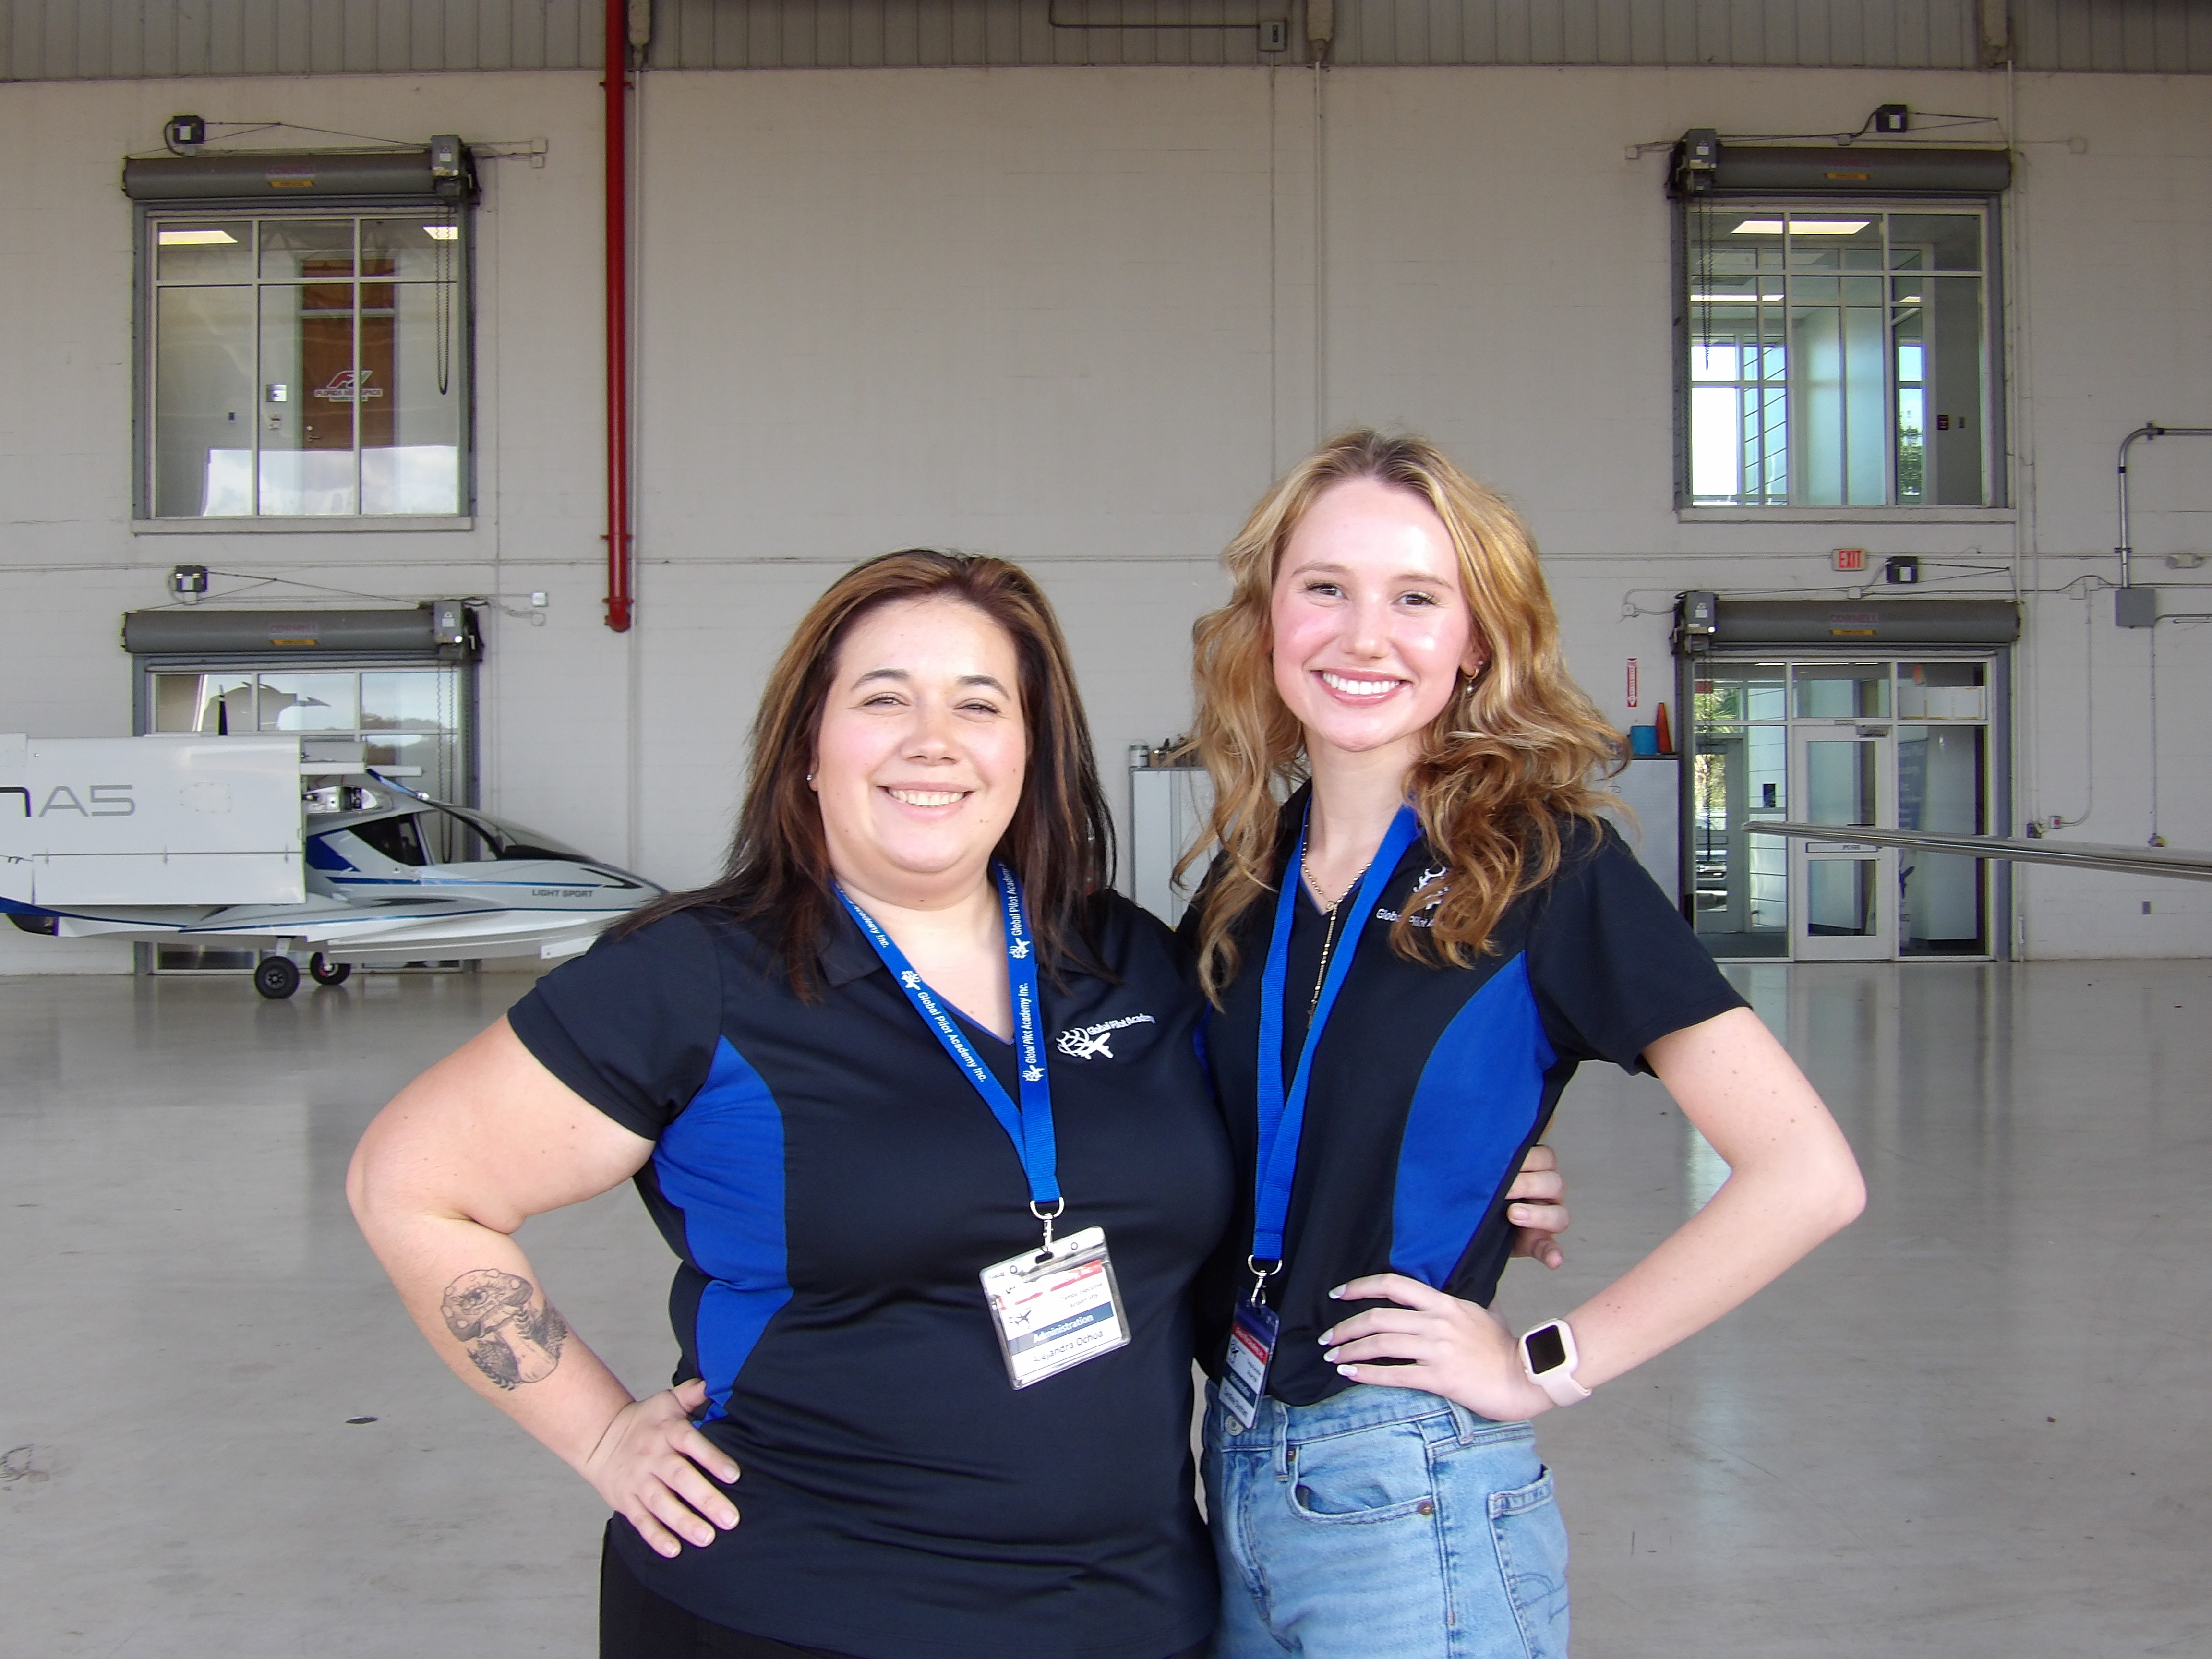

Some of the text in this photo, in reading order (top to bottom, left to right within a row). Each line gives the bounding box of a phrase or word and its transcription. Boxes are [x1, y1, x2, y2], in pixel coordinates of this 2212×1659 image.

[1839, 551, 1861, 568] EXIT
[1008, 896, 1020, 912] Pilot
[1011, 913, 1022, 936] Global
[1019, 998, 1032, 1030] Academy
[917, 992, 941, 1016] Global
[934, 1016, 953, 1034] Pilot
[946, 1034, 978, 1068] Academy
[1022, 1030, 1034, 1045] Pilot
[1023, 1044, 1037, 1064] Global
[1033, 1315, 1094, 1344] Administration
[1076, 1331, 1103, 1346] Ochoa
